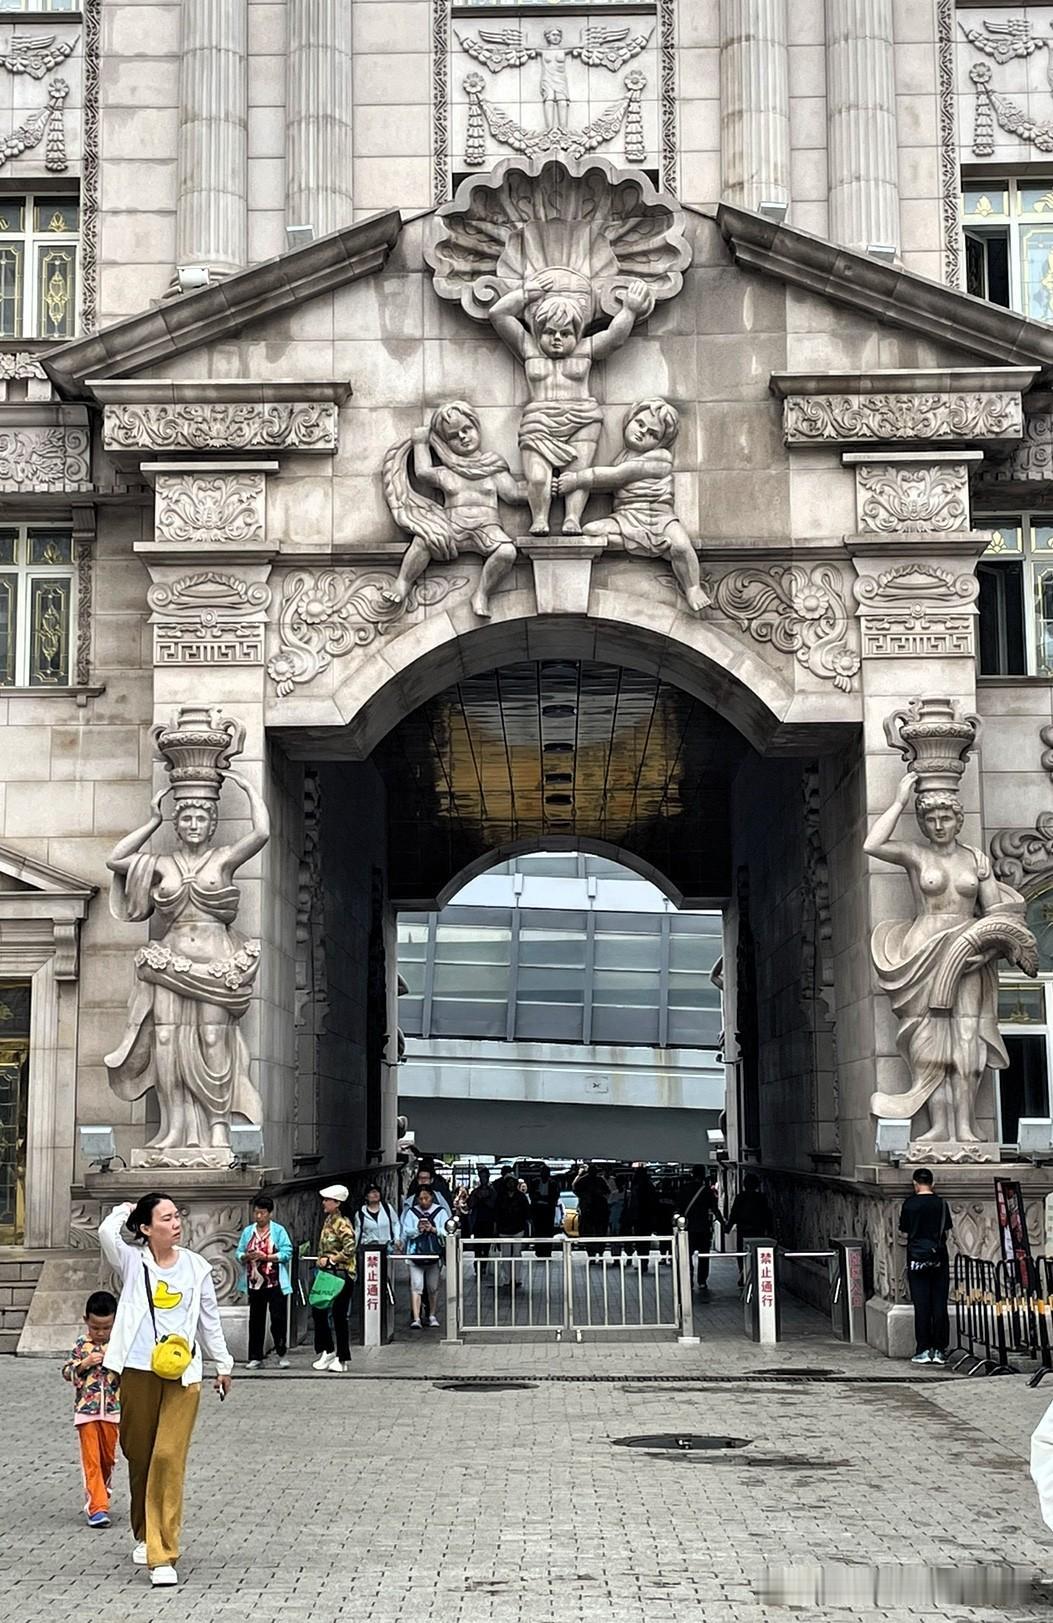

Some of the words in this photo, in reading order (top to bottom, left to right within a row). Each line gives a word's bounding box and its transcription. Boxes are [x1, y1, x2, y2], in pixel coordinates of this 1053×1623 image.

[366, 1255, 378, 1311] 禁止通行
[760, 1252, 773, 1307] 禁止通行
